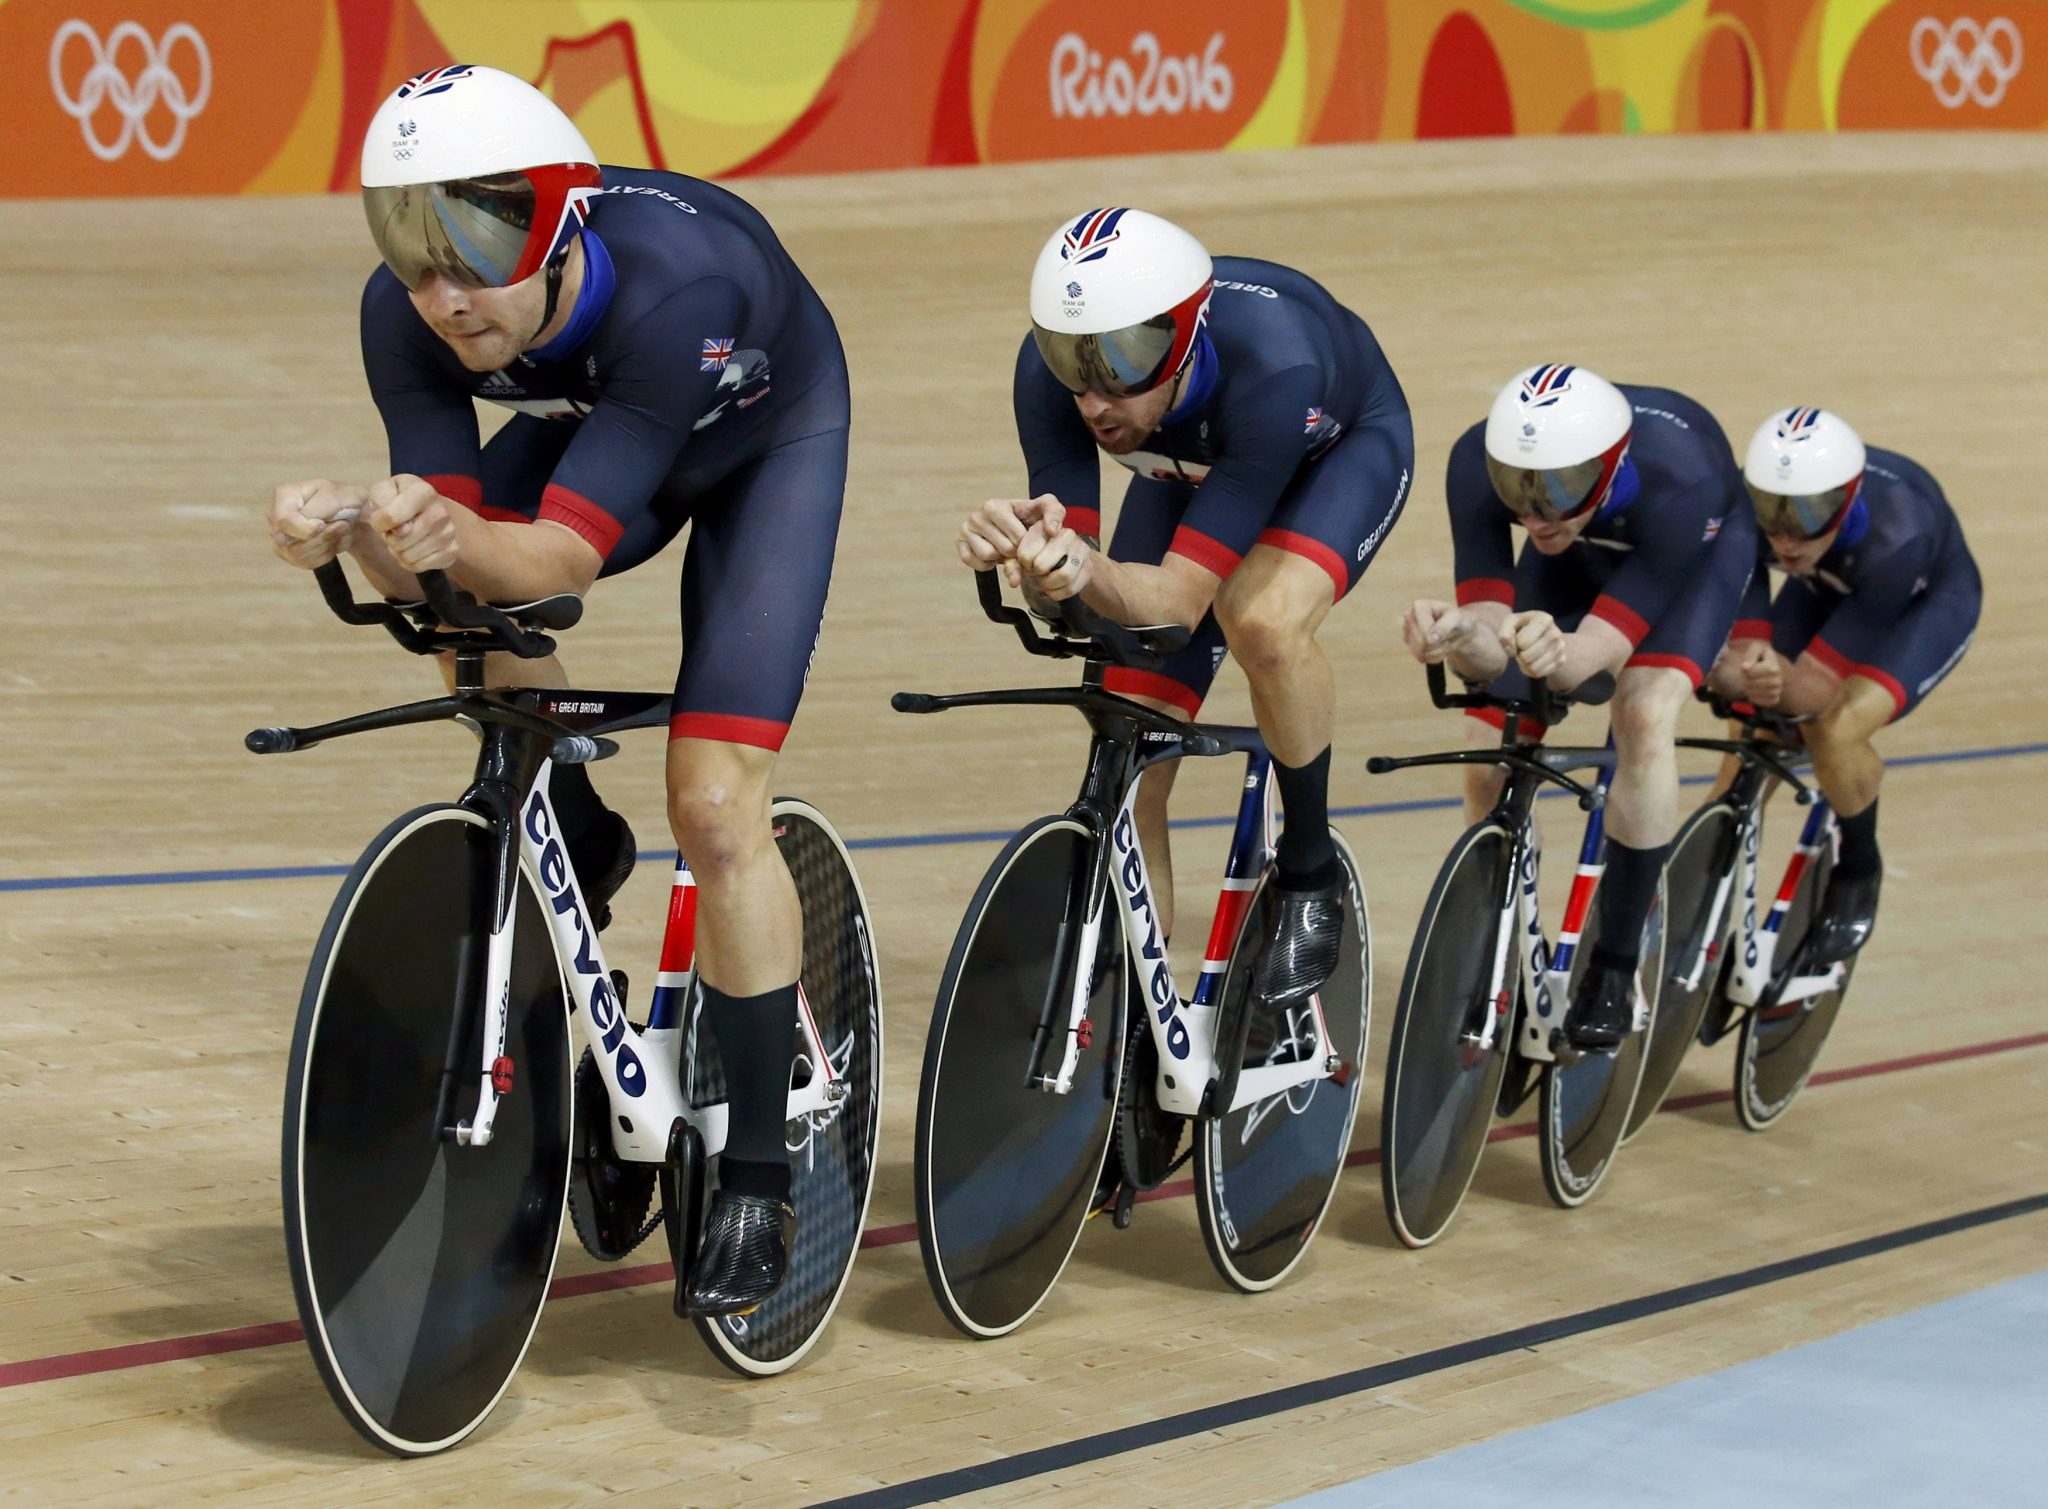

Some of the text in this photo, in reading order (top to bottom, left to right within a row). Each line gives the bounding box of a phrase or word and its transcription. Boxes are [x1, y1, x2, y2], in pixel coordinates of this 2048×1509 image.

[603, 185, 698, 214] GREAT
[1213, 279, 1279, 299] GREA
[558, 701, 605, 714] GREAT BRITAIN
[1149, 731, 1165, 741] GREAT
